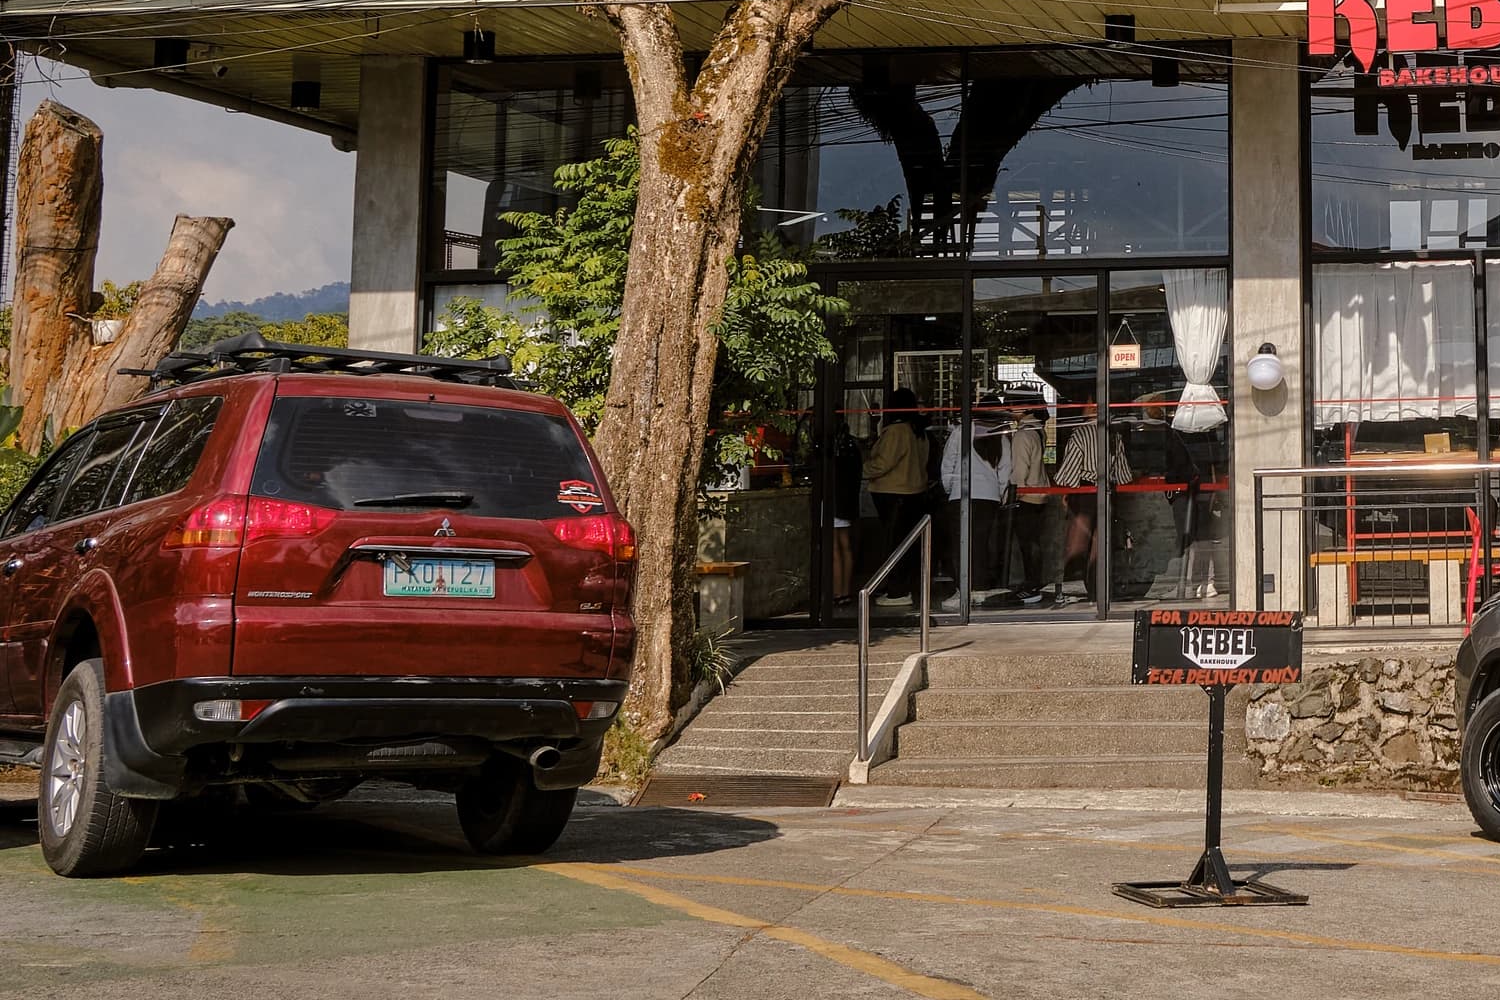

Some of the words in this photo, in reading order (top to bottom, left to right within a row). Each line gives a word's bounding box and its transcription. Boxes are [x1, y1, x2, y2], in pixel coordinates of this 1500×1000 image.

[1114, 353, 1136, 361] OPEN
[450, 562, 488, 585] 127
[1151, 610, 1181, 625] FOR
[1187, 611, 1256, 625] DELIVERY
[1258, 611, 1293, 625] ONLY
[1180, 626, 1256, 658] REBEL
[1148, 668, 1184, 684] FOR
[1186, 668, 1258, 684] DELIVERY
[1262, 667, 1299, 683] ONLY
